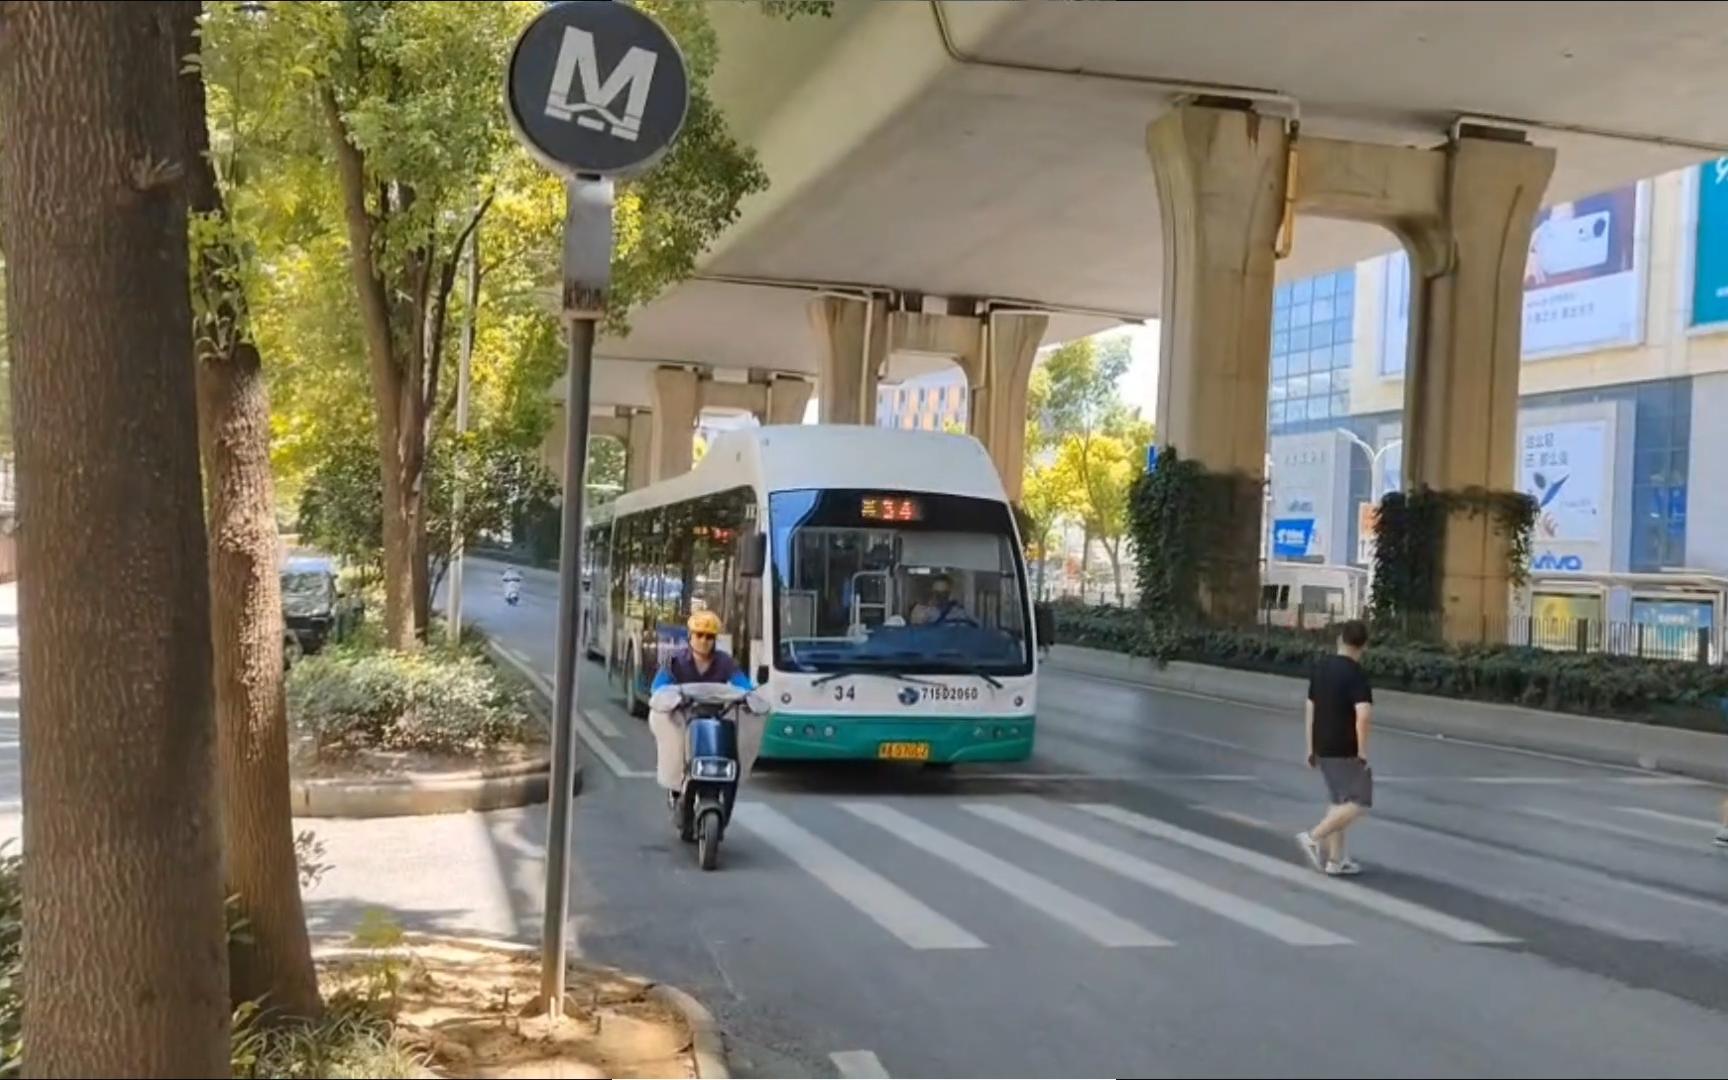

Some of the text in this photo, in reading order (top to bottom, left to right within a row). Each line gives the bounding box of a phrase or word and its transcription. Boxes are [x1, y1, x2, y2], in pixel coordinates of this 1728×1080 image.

[544, 26, 657, 140] M
[882, 499, 913, 519] 34
[1532, 551, 1583, 570] vivo
[834, 685, 855, 701] 34
